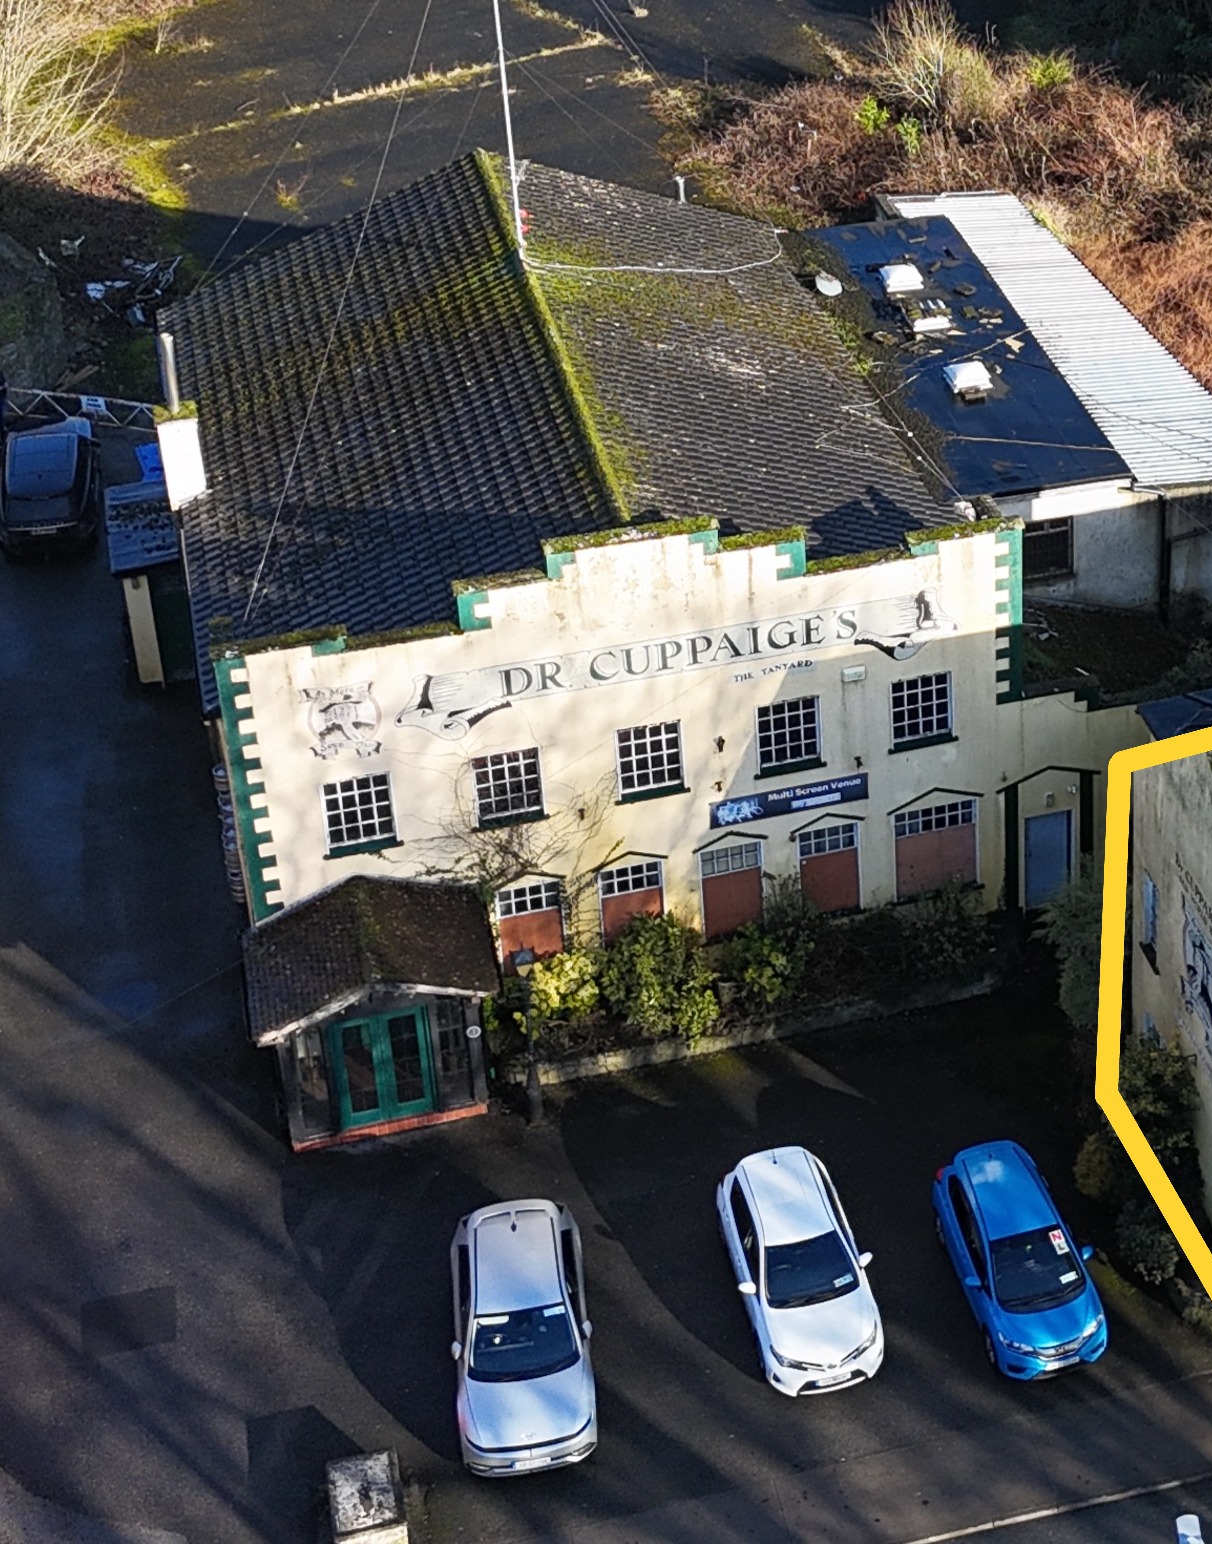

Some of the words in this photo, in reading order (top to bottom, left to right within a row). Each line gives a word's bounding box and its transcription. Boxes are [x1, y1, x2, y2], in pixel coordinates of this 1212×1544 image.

[590, 610, 858, 681] CUPPAIGE'S
[733, 671, 754, 682] THE
[761, 659, 813, 676] TANYARD
[767, 789, 793, 801] Multi
[795, 784, 828, 796] Screen
[830, 778, 861, 789] Venue
[1051, 1231, 1062, 1241] N
